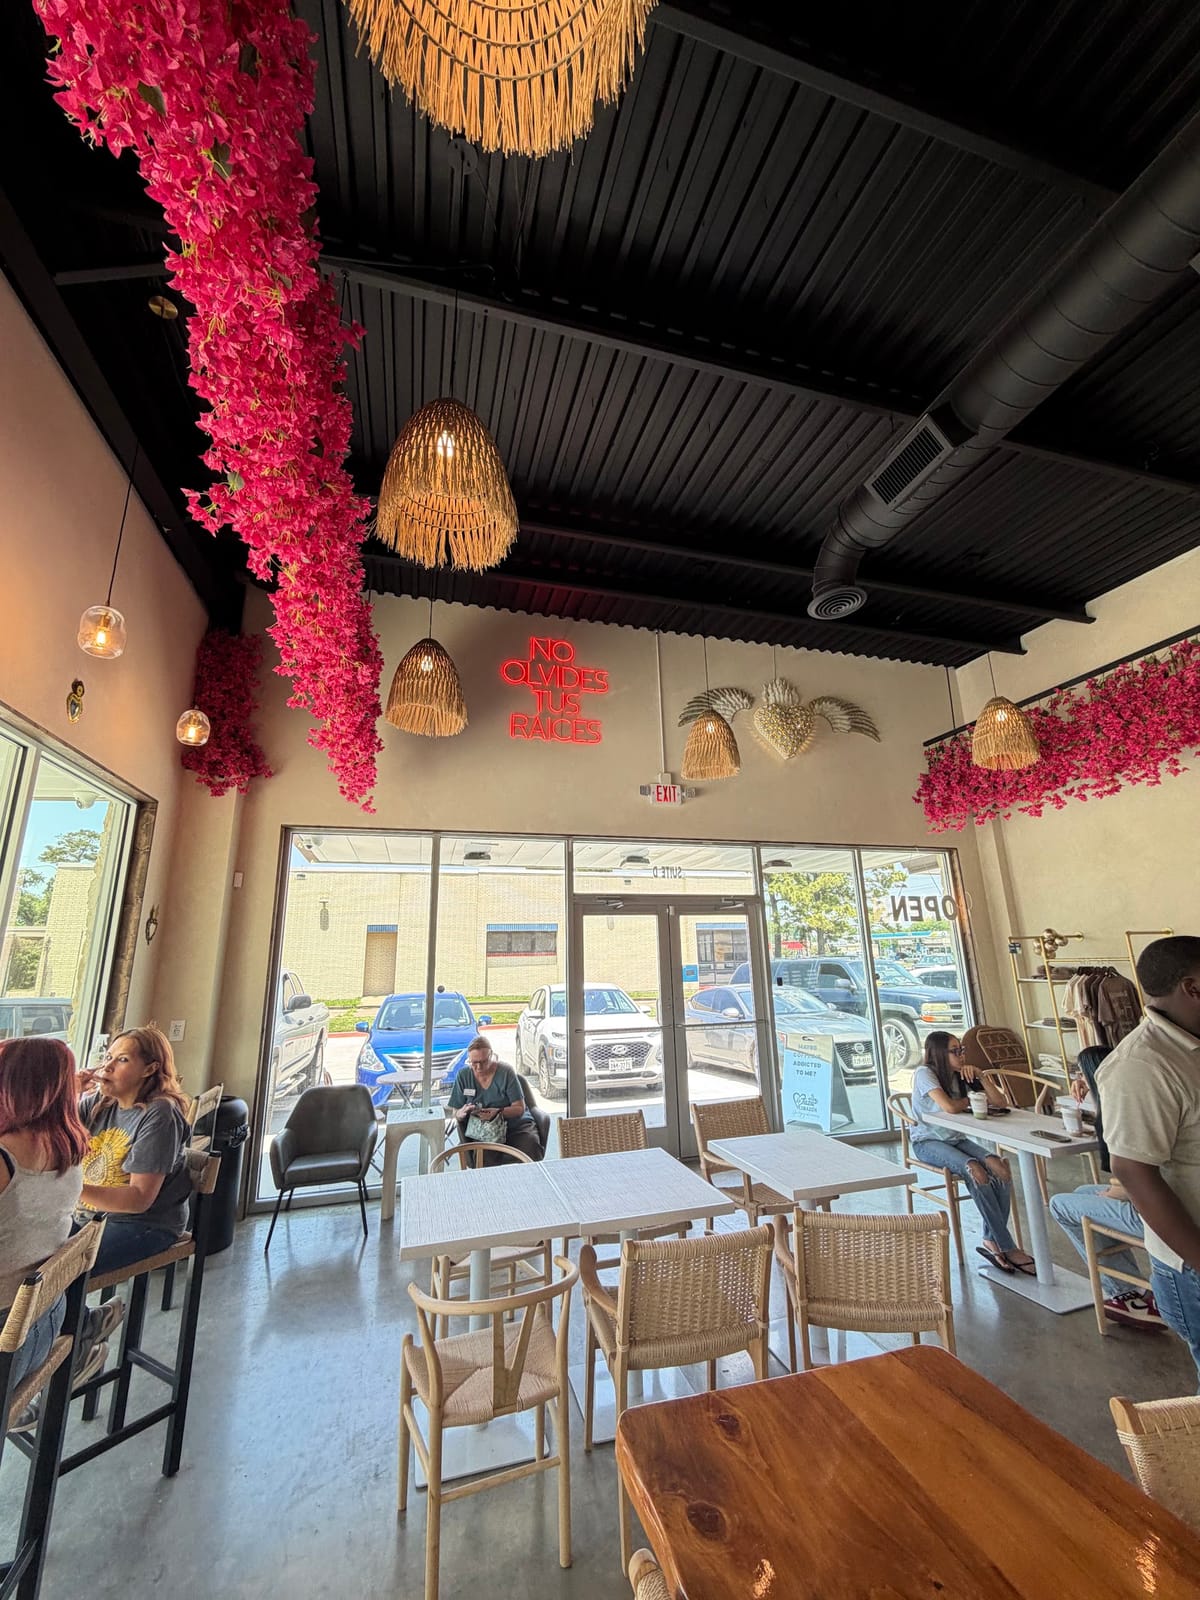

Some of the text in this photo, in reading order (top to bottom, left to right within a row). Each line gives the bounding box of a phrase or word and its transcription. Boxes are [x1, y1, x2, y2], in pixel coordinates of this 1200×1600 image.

[530, 636, 575, 663] NO
[502, 660, 609, 693] OLVIDES
[531, 689, 580, 714] TUS
[510, 713, 602, 744] RAICES
[656, 785, 677, 803] EXIT
[793, 1060, 822, 1069] ADDICTED
